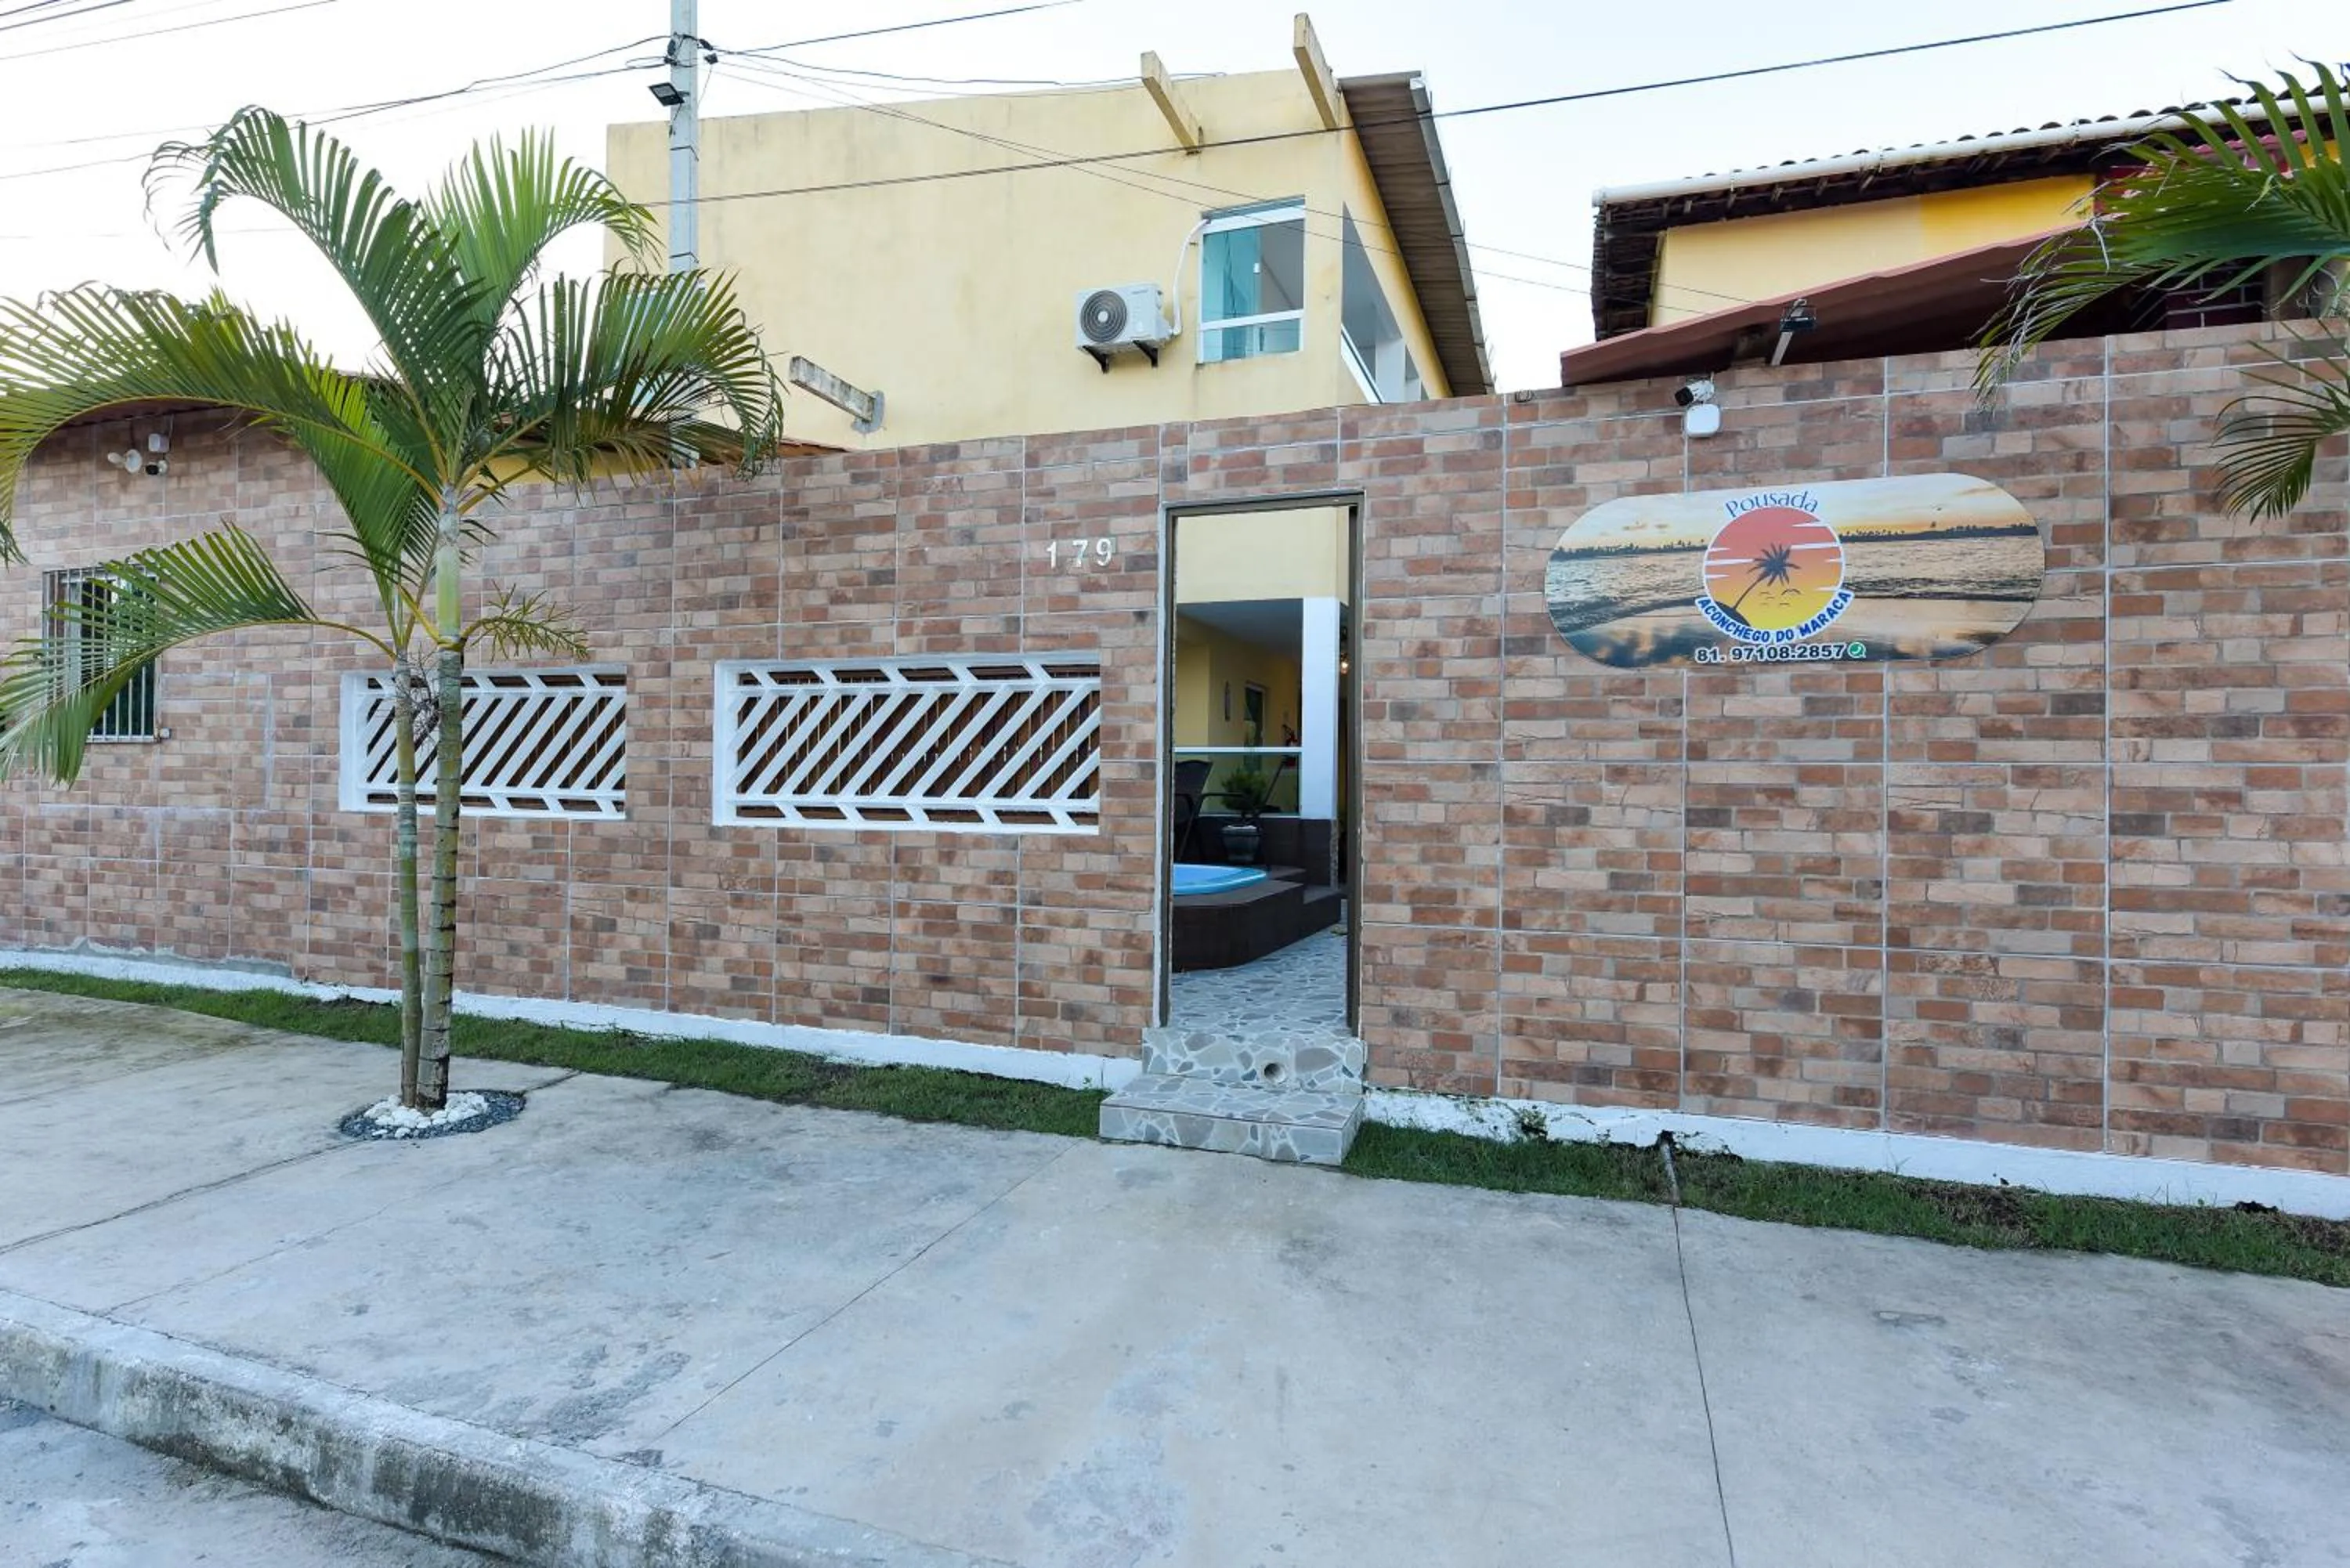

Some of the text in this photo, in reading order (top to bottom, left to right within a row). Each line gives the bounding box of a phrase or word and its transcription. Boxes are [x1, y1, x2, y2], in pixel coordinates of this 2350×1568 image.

[1725, 490, 1819, 518] Pousada
[1046, 538, 1112, 569] 179
[1697, 591, 1852, 643] ACONCHEGO DO MARACA
[1696, 644, 1845, 663] 81. 97108.2857
